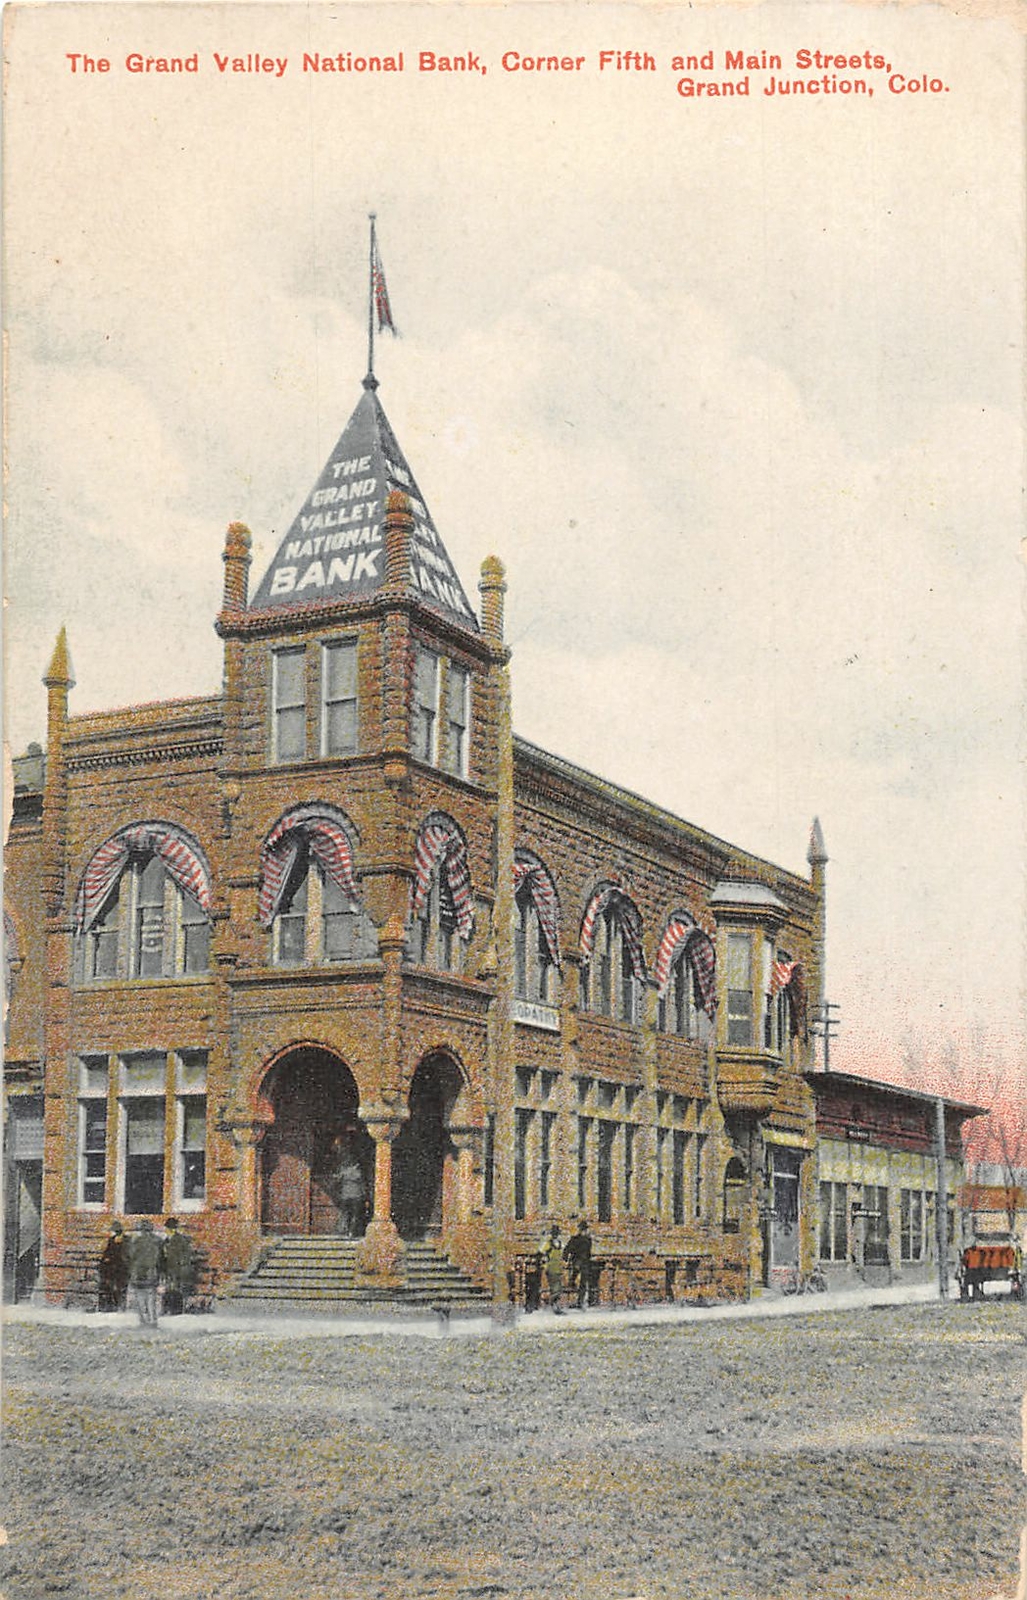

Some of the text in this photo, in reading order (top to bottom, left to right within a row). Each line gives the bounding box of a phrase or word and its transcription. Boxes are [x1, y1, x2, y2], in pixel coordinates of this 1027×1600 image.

[332, 455, 372, 479] THE
[311, 477, 377, 508] GRAND
[300, 501, 379, 532] VALLEY
[284, 524, 383, 560] NATIONAL
[269, 549, 383, 596] BANK
